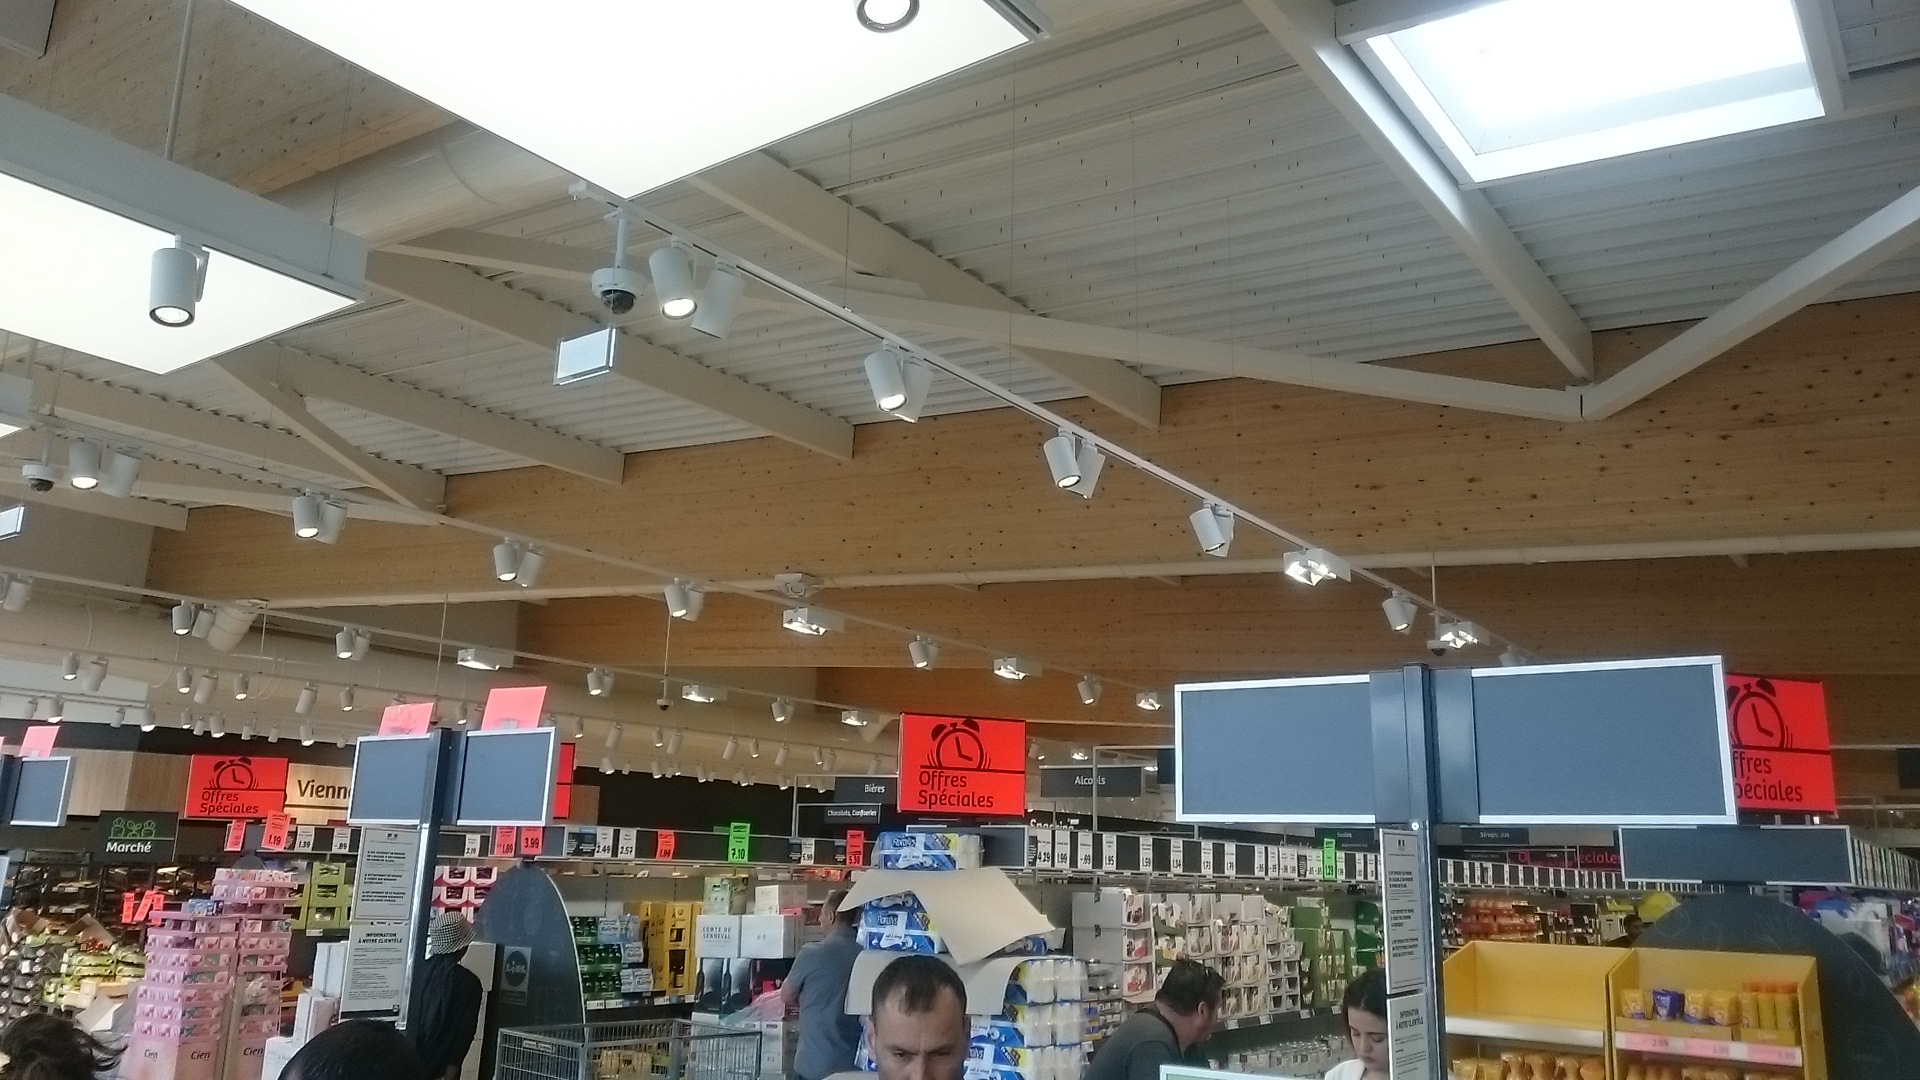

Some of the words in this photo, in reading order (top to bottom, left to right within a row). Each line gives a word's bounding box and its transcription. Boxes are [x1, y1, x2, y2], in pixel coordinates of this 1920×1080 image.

[1732, 751, 1772, 777] ffres
[919, 771, 967, 790] Offres
[297, 778, 350, 800] Vienn
[864, 783, 885, 793] Bières
[201, 791, 239, 803] Offres
[918, 790, 994, 809] Spéciales
[200, 802, 259, 815] Spéciales
[106, 841, 152, 853] Marché
[524, 837, 540, 849] 3.99
[731, 848, 745, 860] 7.10
[144, 1049, 159, 1059] Cien
[190, 1050, 211, 1060] Cien
[243, 1046, 263, 1060] Cien
